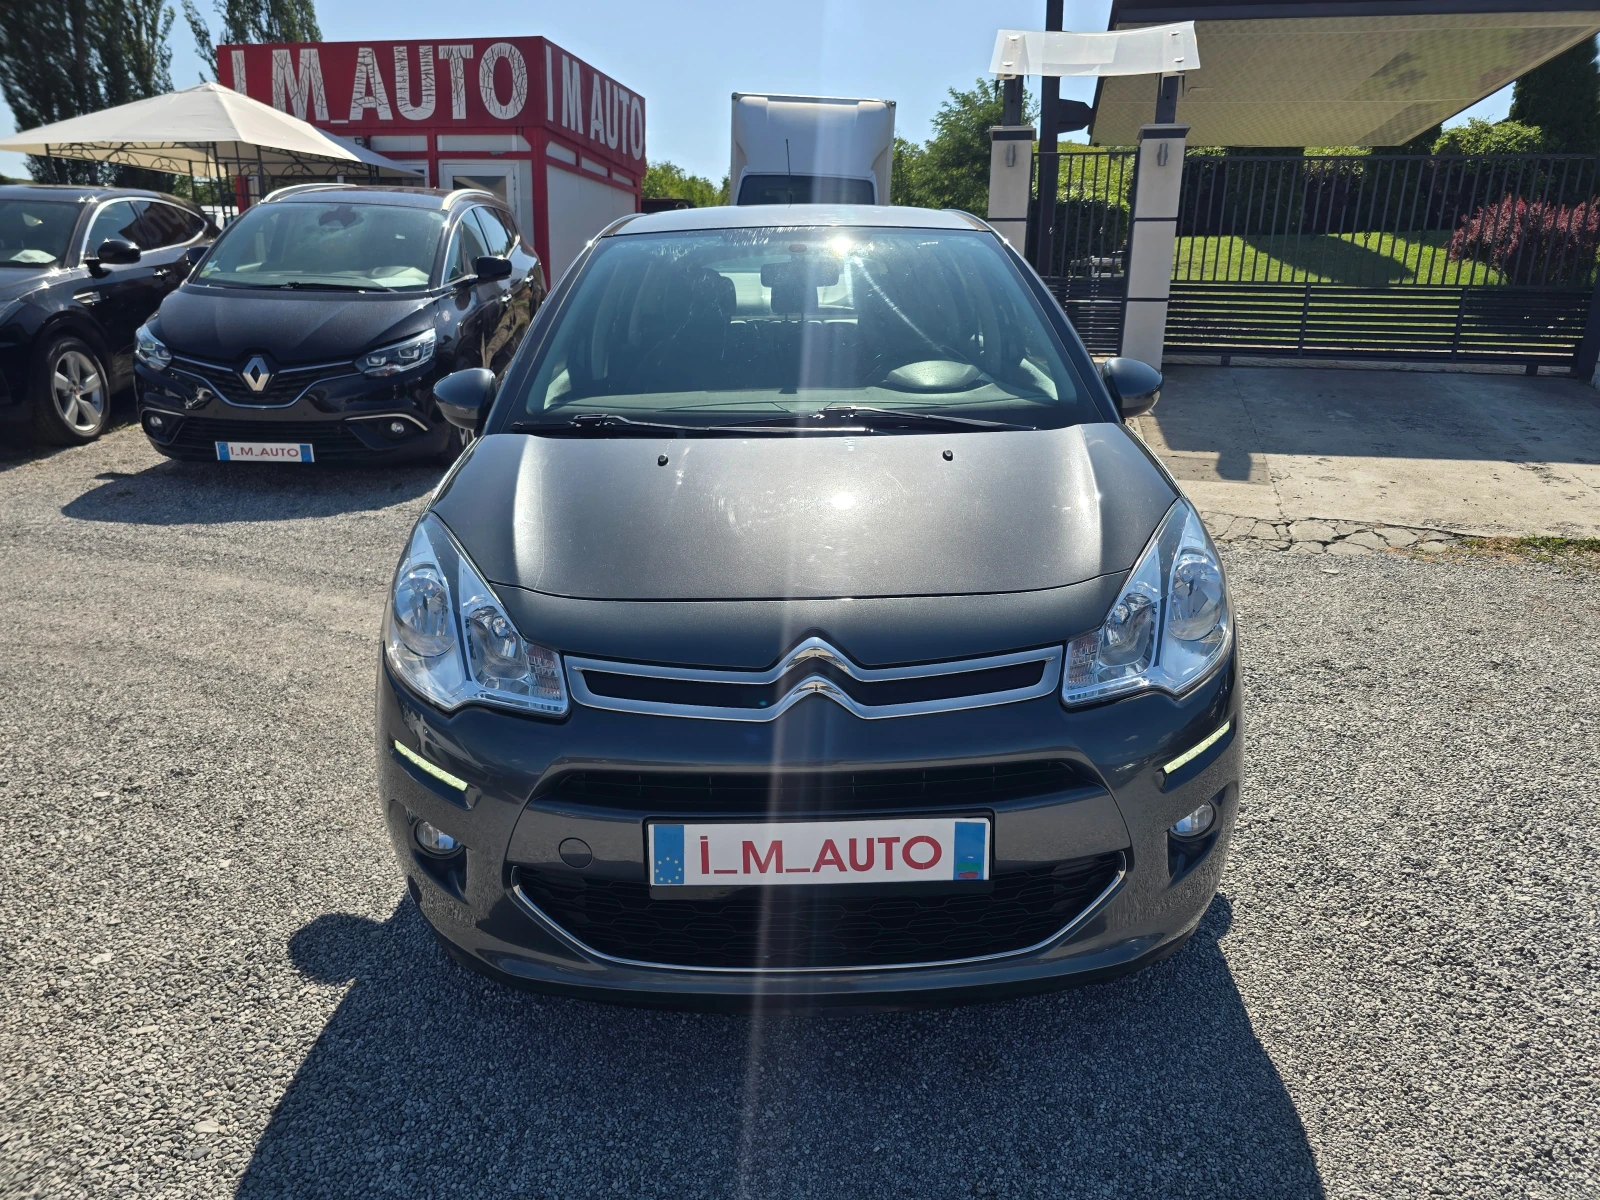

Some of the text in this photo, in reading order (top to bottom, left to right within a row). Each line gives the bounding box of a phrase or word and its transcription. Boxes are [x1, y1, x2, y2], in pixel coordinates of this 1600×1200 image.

[545, 44, 644, 160] I M AUTO
